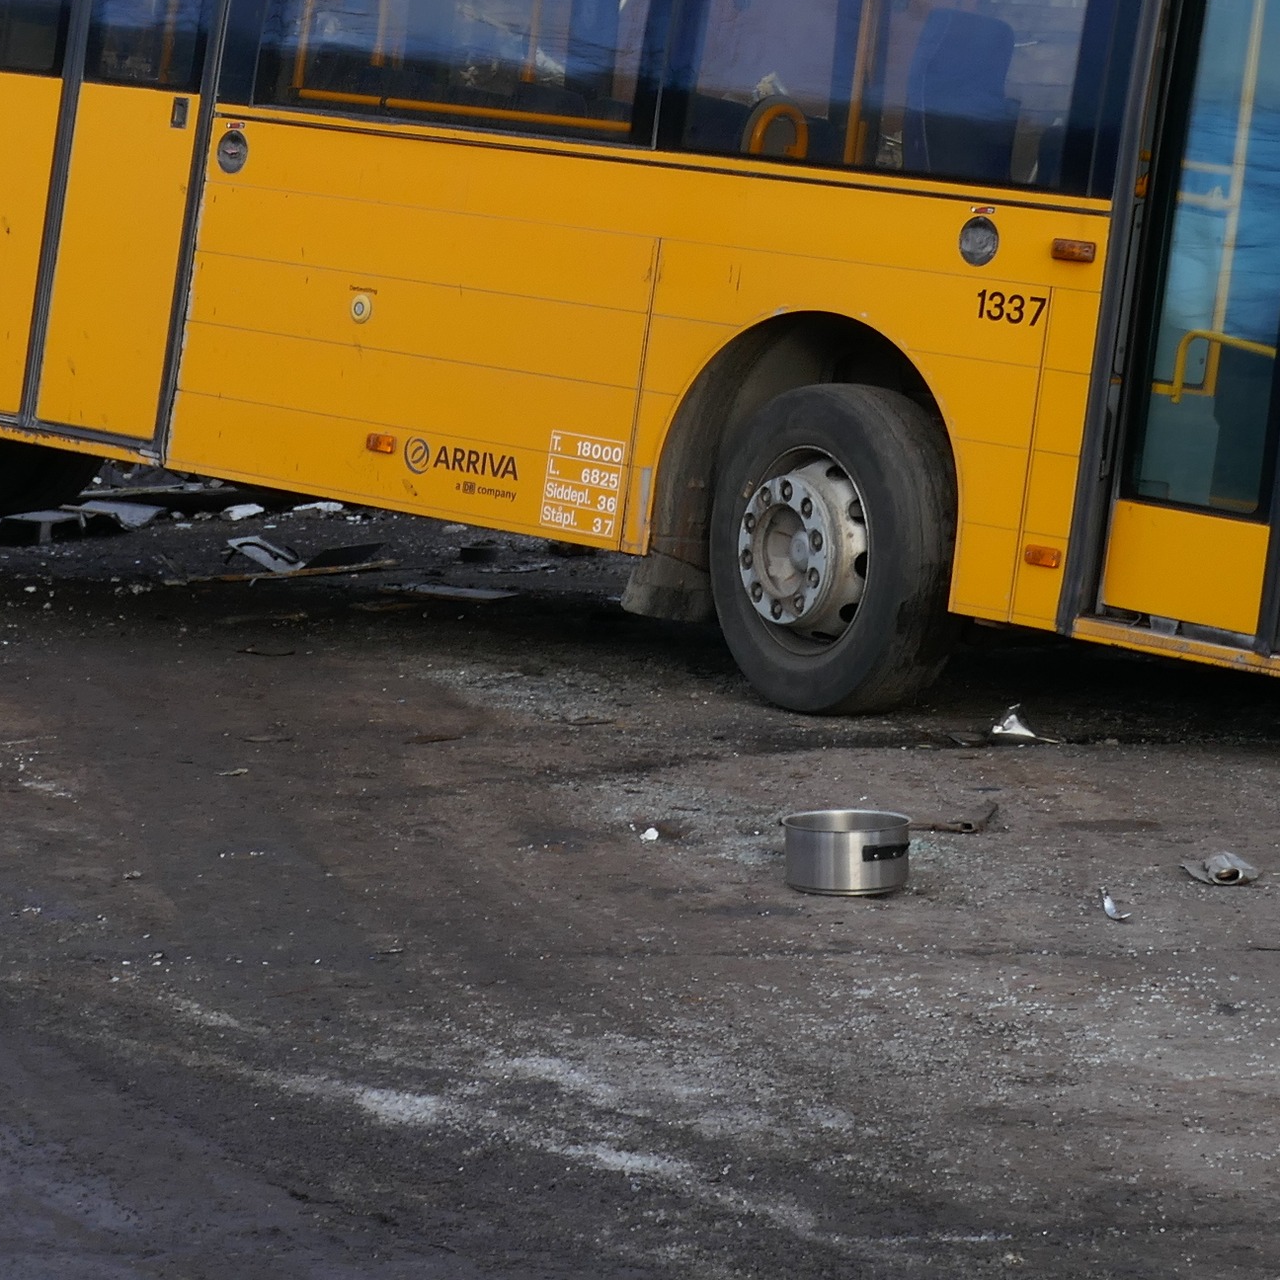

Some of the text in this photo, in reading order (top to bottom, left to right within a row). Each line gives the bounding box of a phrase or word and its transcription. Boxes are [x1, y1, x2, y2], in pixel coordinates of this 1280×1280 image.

[977, 288, 1047, 327] 1337
[433, 446, 518, 481] ARRIVA
[552, 435, 621, 462] T. 18000
[549, 458, 618, 489] L. 6825
[477, 486, 517, 502] company
[545, 482, 616, 512] Siddepl. 36
[542, 505, 613, 535] Ståpl. 37
